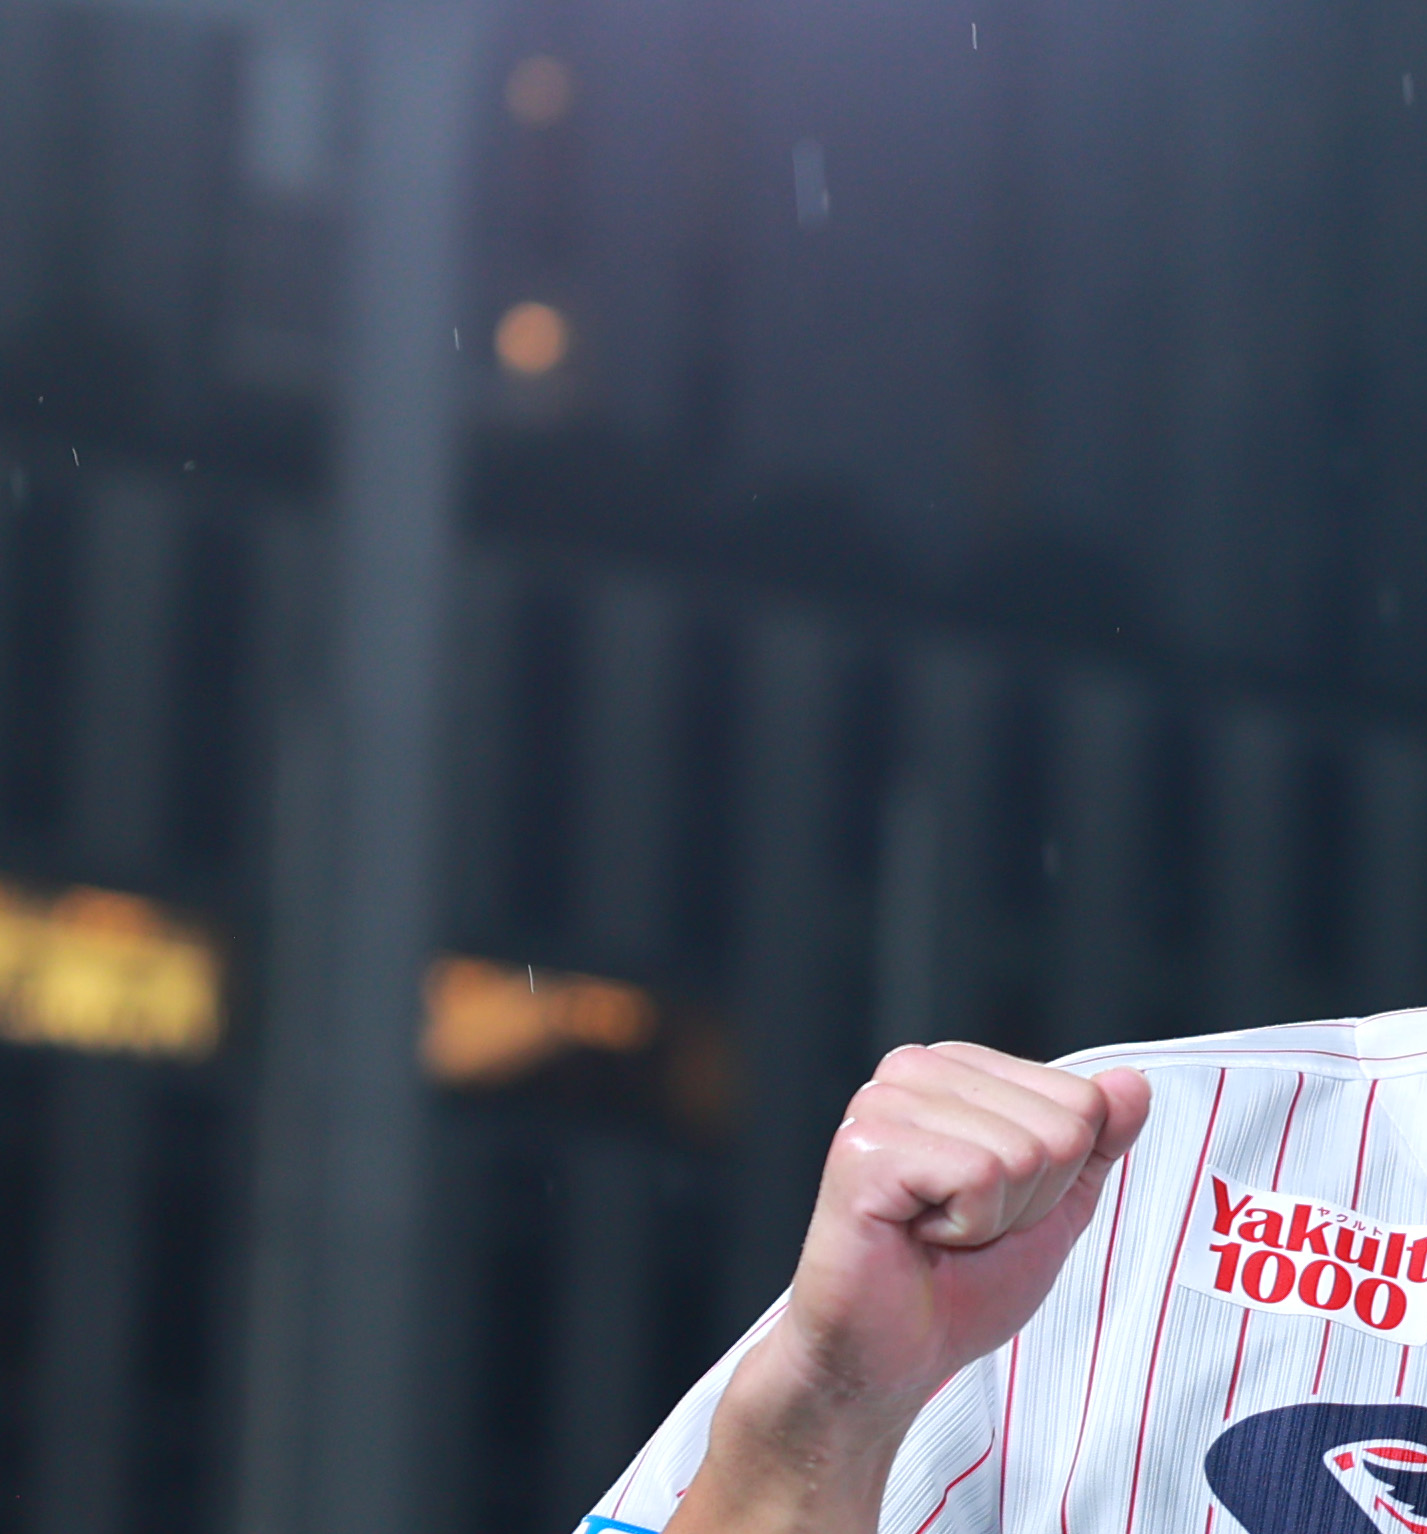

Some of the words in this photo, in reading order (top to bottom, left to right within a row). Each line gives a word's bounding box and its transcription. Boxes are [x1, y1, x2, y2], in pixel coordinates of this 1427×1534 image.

[1317, 1206, 1383, 1236] ヤクルト
[1209, 1242, 1408, 1331] 1000
